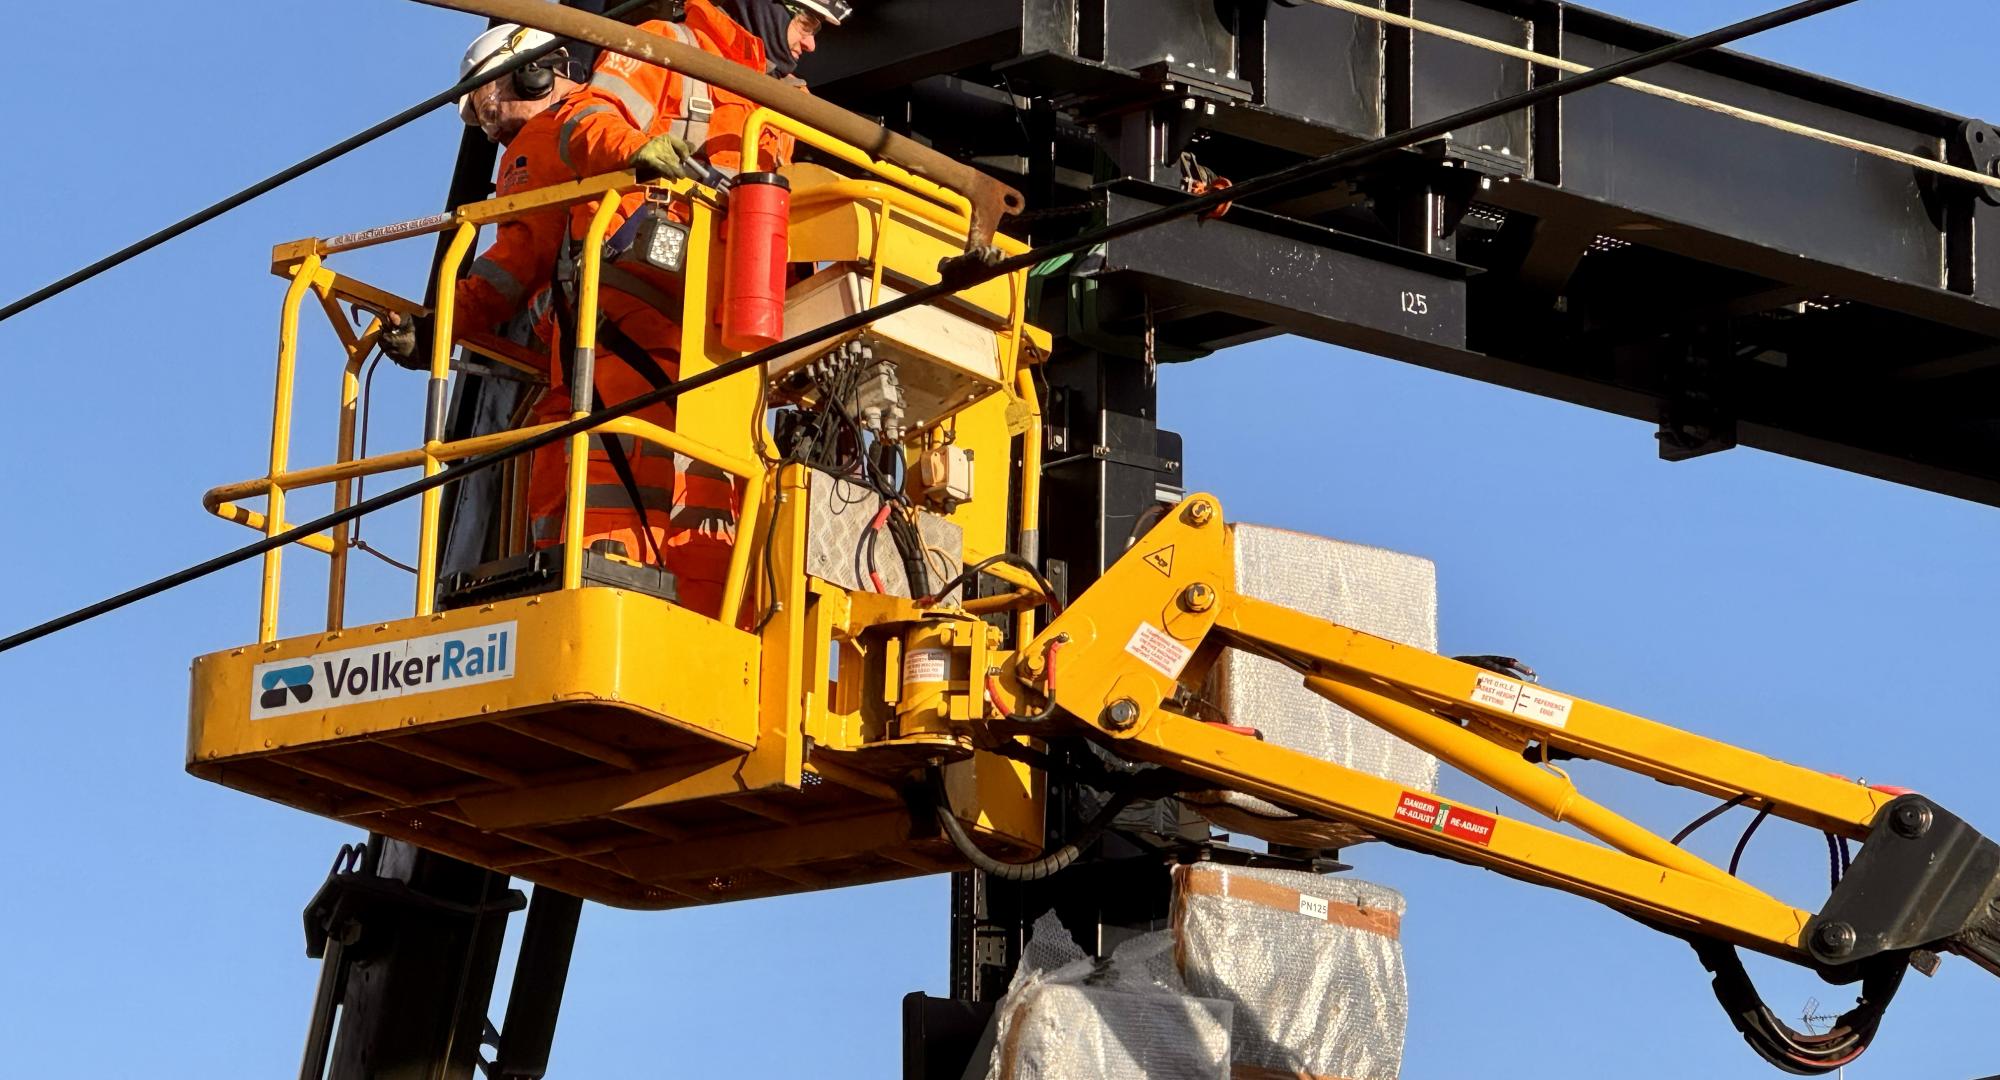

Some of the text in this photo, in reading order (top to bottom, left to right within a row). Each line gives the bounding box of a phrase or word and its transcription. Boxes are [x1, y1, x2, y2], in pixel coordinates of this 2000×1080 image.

[1401, 291, 1428, 315] 125
[323, 631, 508, 699] VolkerRail
[1396, 806, 1436, 824] RE-ADJUST
[1450, 817, 1489, 835] RE-ADJUST
[1301, 900, 1327, 914] PN125
